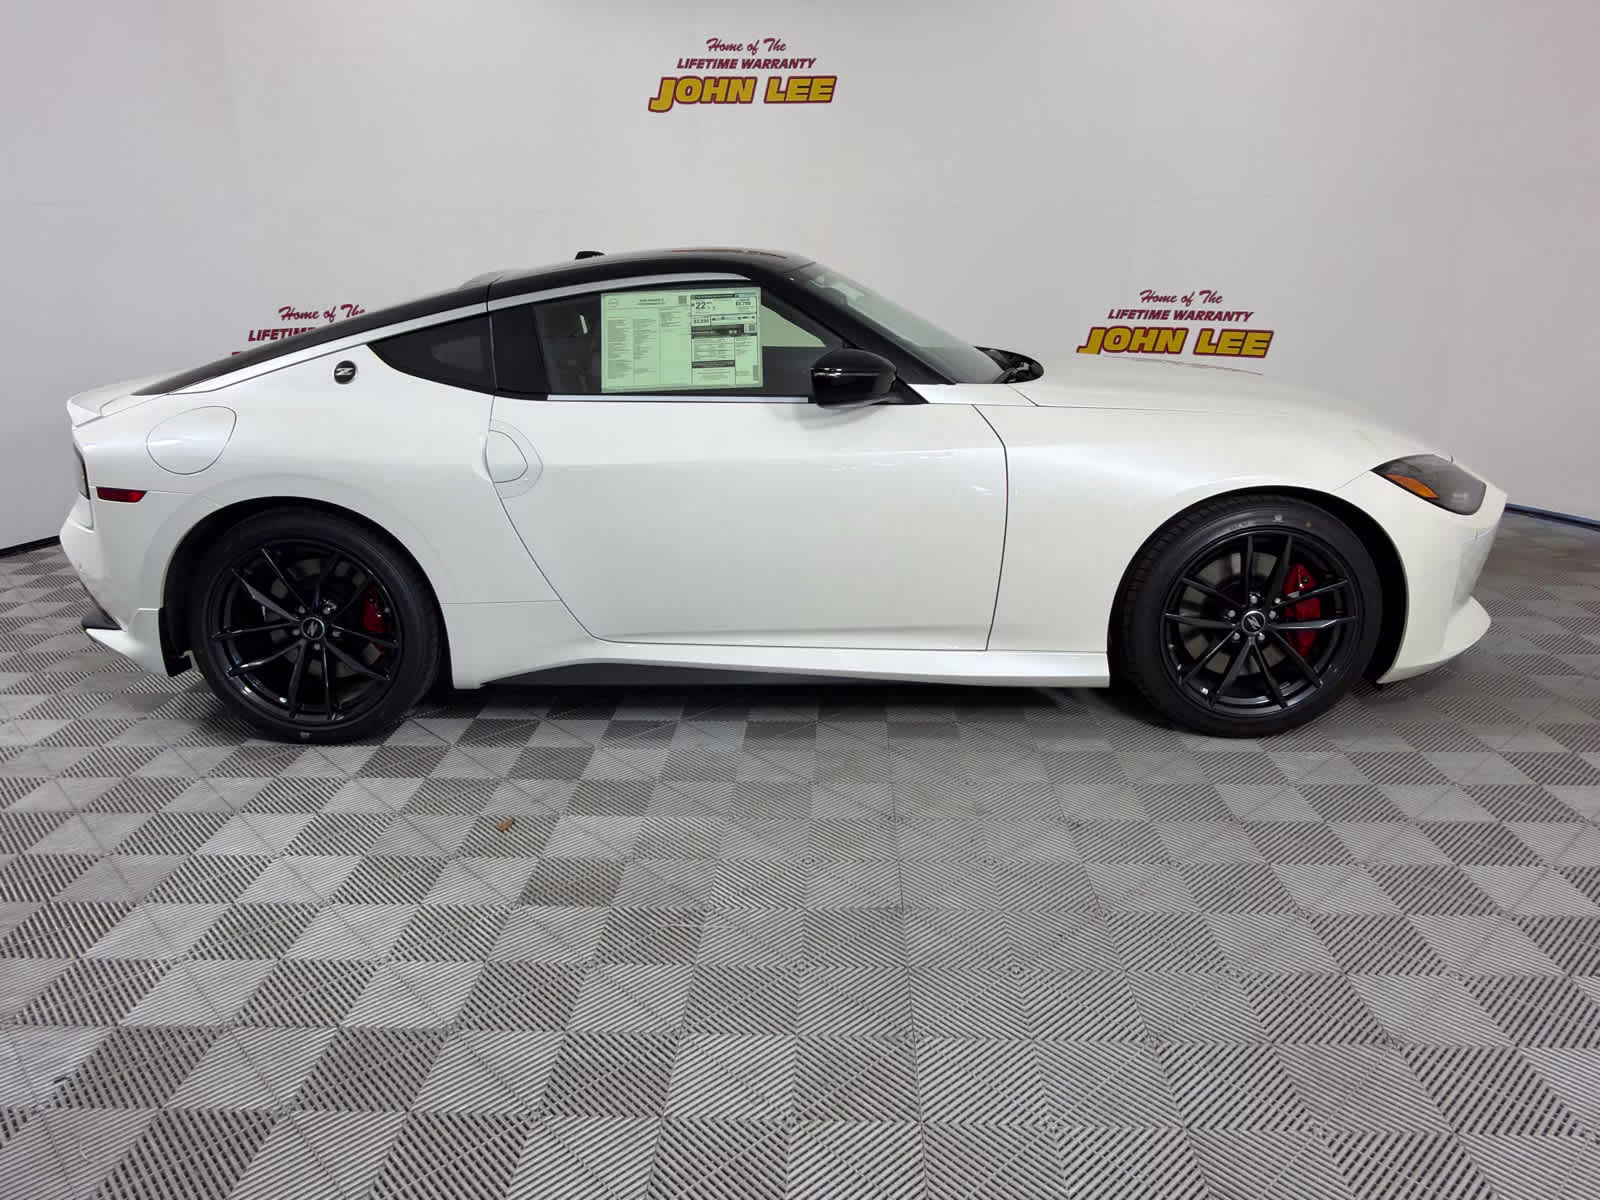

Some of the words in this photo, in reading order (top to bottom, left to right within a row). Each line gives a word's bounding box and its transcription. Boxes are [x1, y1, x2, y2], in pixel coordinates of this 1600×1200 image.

[706, 38, 743, 52] Home
[746, 39, 759, 55] of
[763, 38, 786, 52] The
[676, 58, 738, 69] LIFETIME
[741, 58, 817, 69] WARRANTY
[648, 75, 757, 113] JOHN
[763, 75, 837, 104] LEE
[1139, 289, 1177, 304] Home
[1181, 291, 1194, 307] of
[1199, 290, 1223, 304] The
[278, 306, 320, 320] Home
[323, 306, 336, 323] of
[1107, 309, 1171, 320] LIFETIME
[1173, 309, 1254, 322] WARRANTY
[1076, 325, 1189, 355] JOHN
[1192, 328, 1275, 358] LEE
